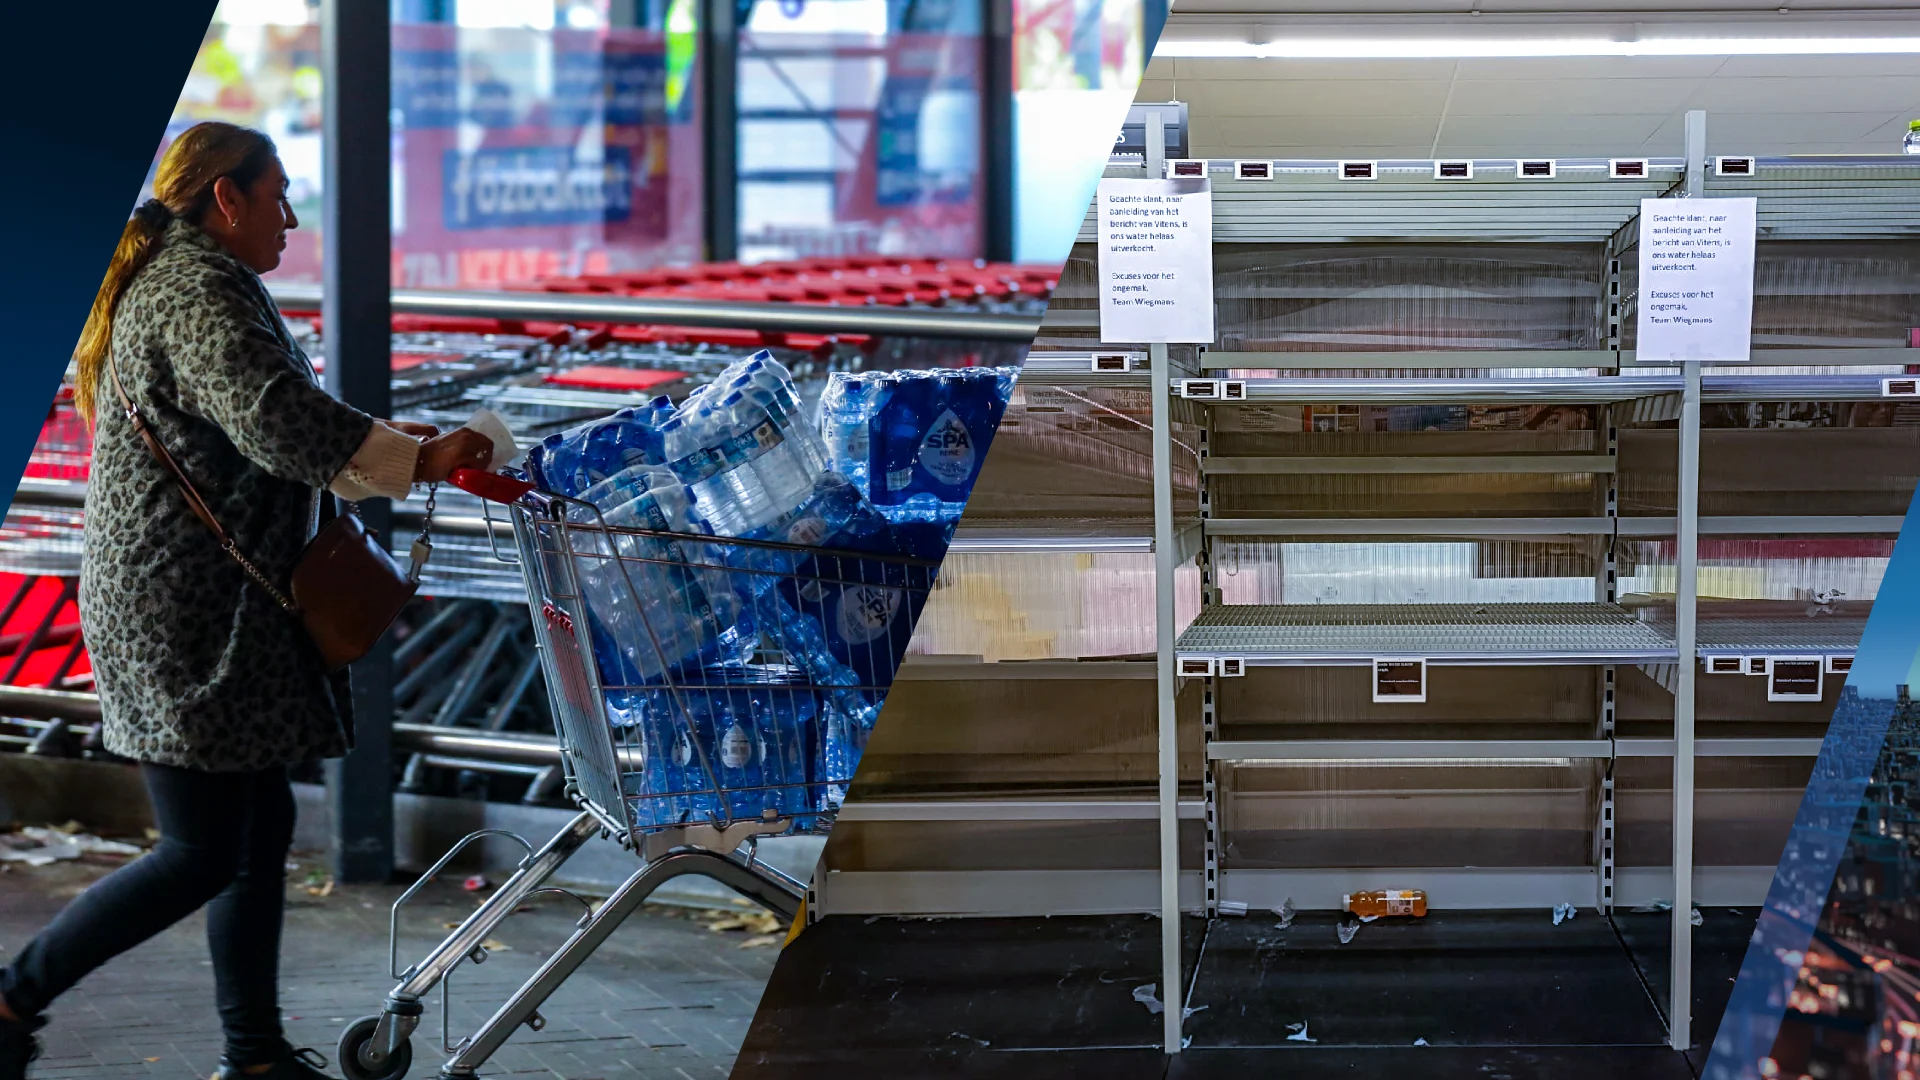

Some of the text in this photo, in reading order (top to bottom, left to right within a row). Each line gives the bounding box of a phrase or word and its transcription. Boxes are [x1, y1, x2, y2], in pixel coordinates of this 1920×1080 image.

[1109, 195, 1142, 203] Geachte
[1109, 207, 1149, 217] aanleiding
[1166, 207, 1179, 216] het
[1653, 214, 1685, 222] Geachte
[1110, 220, 1137, 228] bericht
[1155, 220, 1180, 229] Vitens,
[1182, 220, 1188, 228] is
[1652, 227, 1692, 235] aanleiding
[1149, 232, 1175, 240] helaas
[1696, 239, 1723, 247] Vitens,
[1111, 244, 1157, 252] uitverkocht.
[1667, 251, 1690, 259] water
[1691, 250, 1716, 259] helaas
[1651, 263, 1697, 271] uitverkocht.
[1112, 272, 1141, 280] Excuses
[1161, 272, 1175, 280] het
[1651, 290, 1714, 299] Excuses voor het
[1112, 298, 1133, 306] Team
[1650, 316, 1671, 324] Team
[927, 432, 969, 449] SPA
